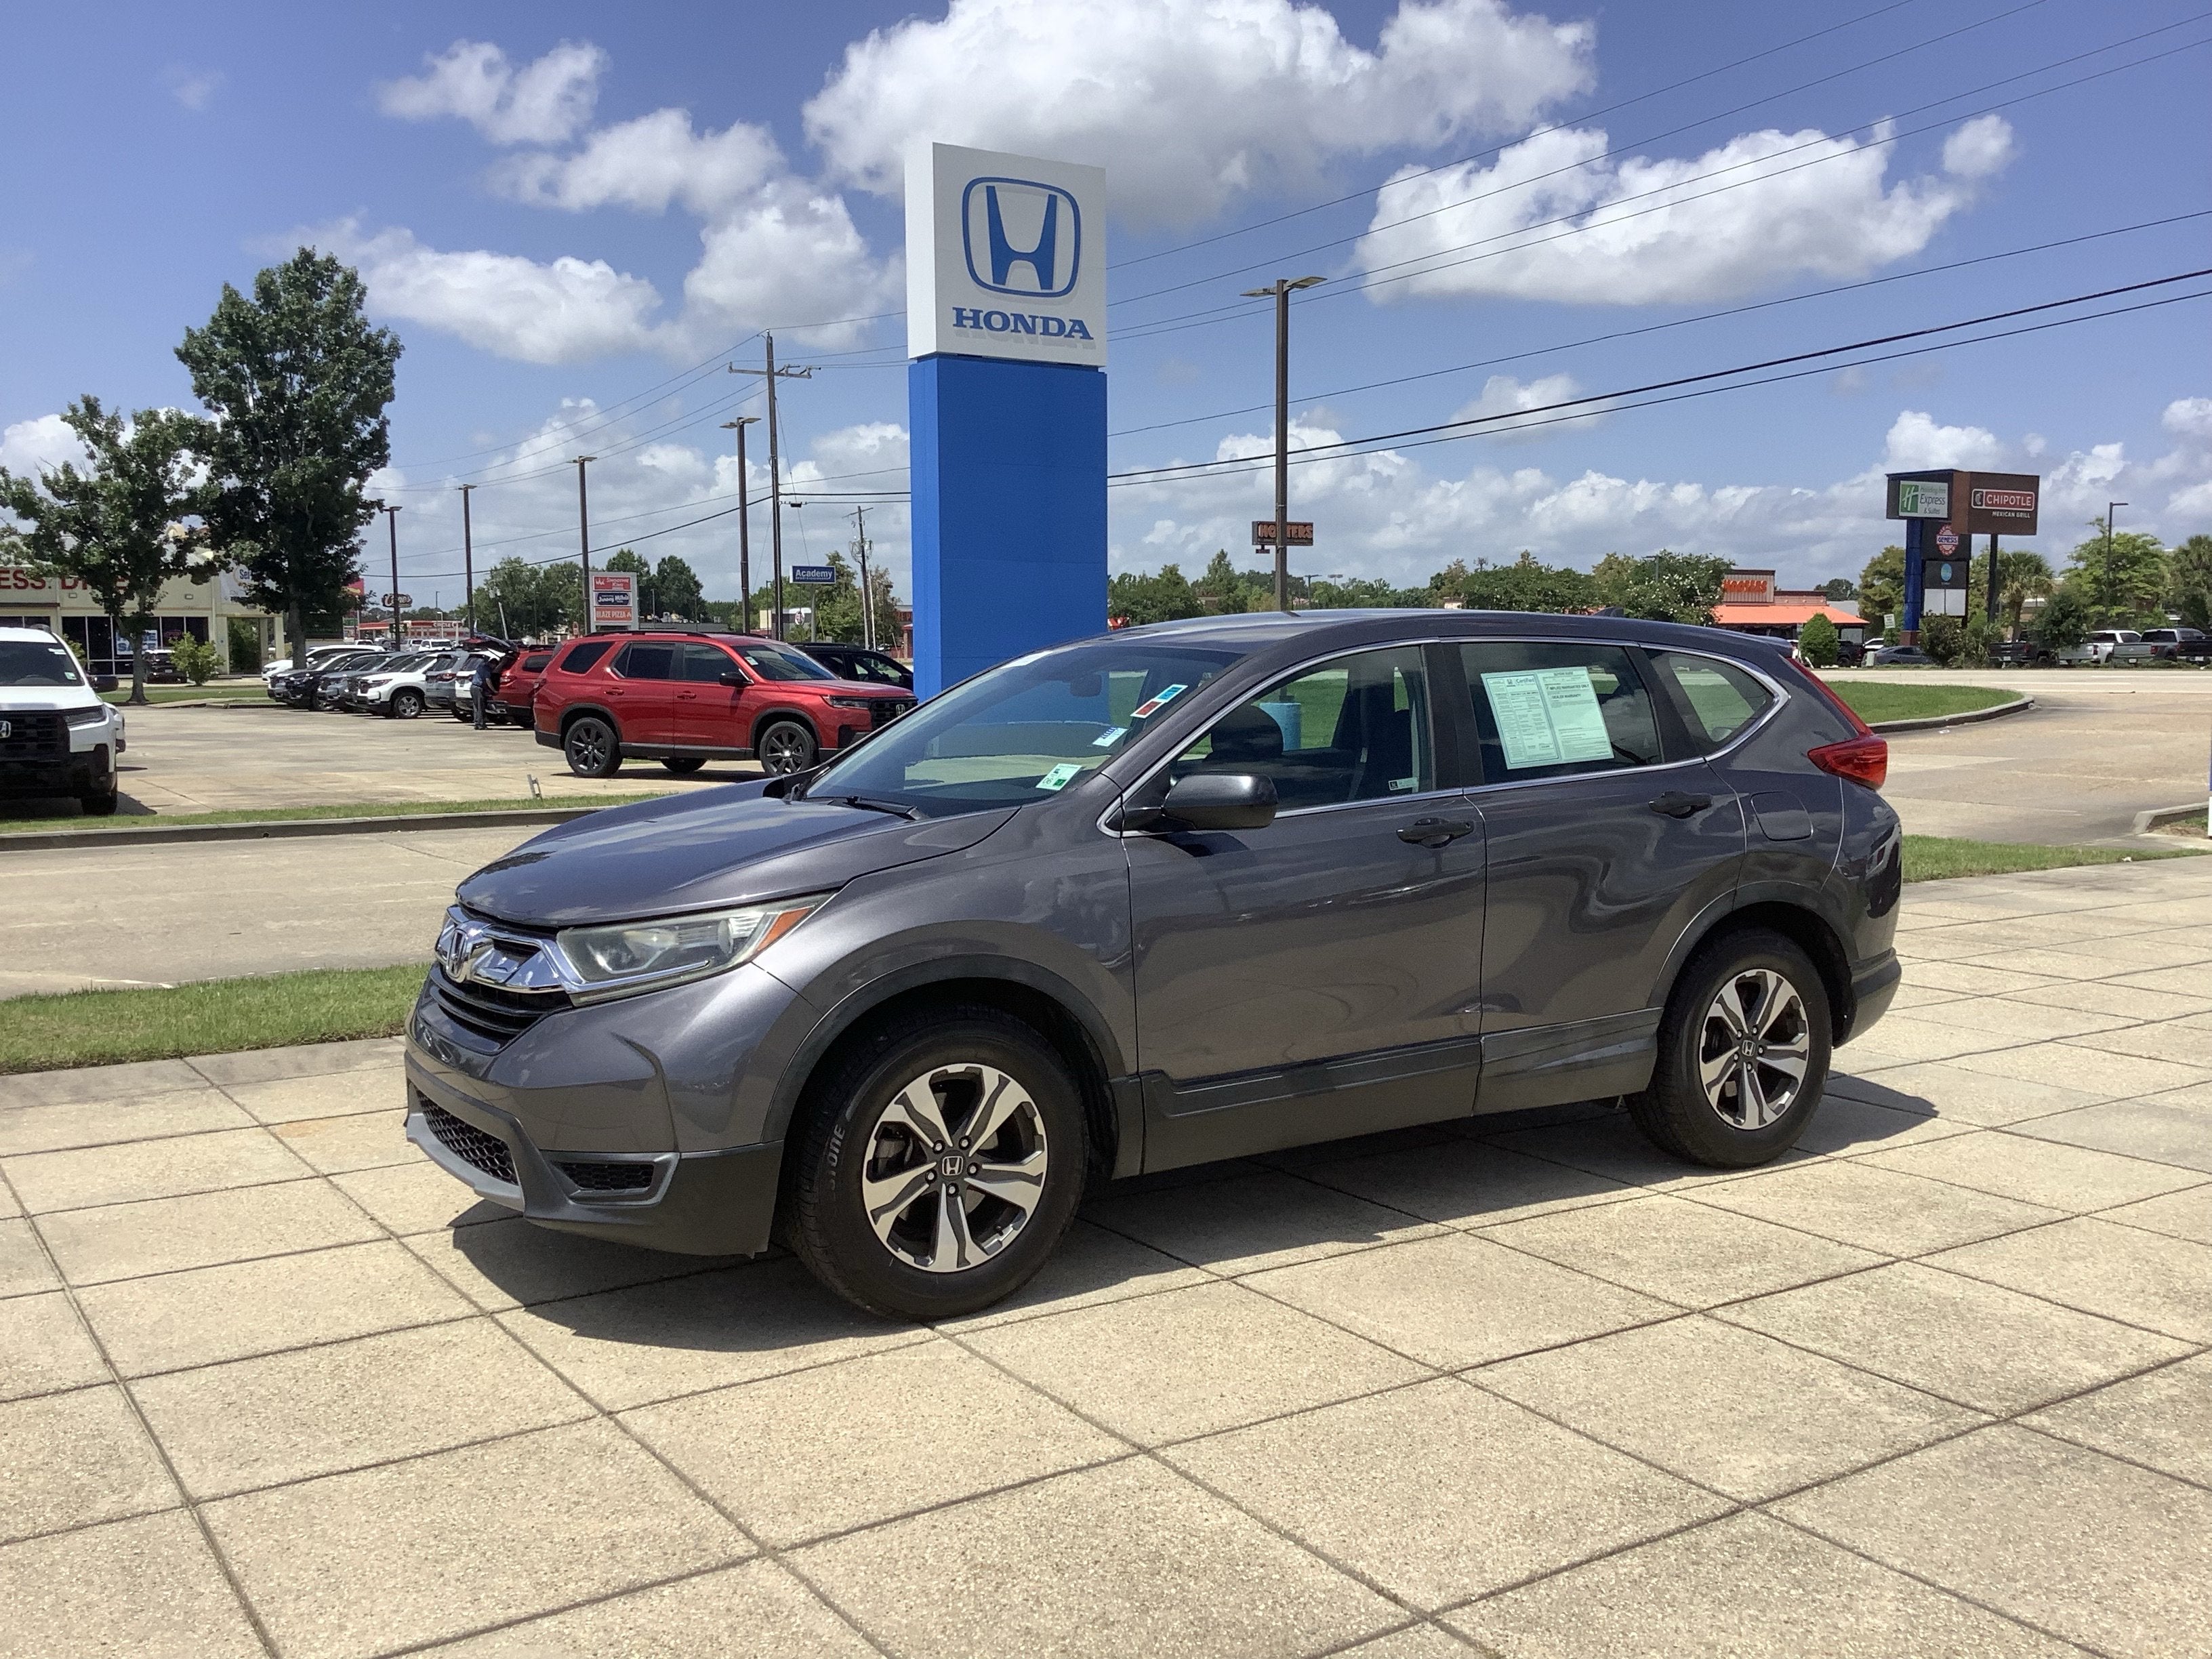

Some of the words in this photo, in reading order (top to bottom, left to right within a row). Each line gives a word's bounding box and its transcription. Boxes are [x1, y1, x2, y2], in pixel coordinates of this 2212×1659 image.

[952, 306, 1094, 340] HONDA
[1920, 493, 1946, 507] Express
[1986, 494, 2032, 506] CHIPOTLE
[1258, 524, 1313, 539] HOTERS
[795, 569, 833, 579] Academy
